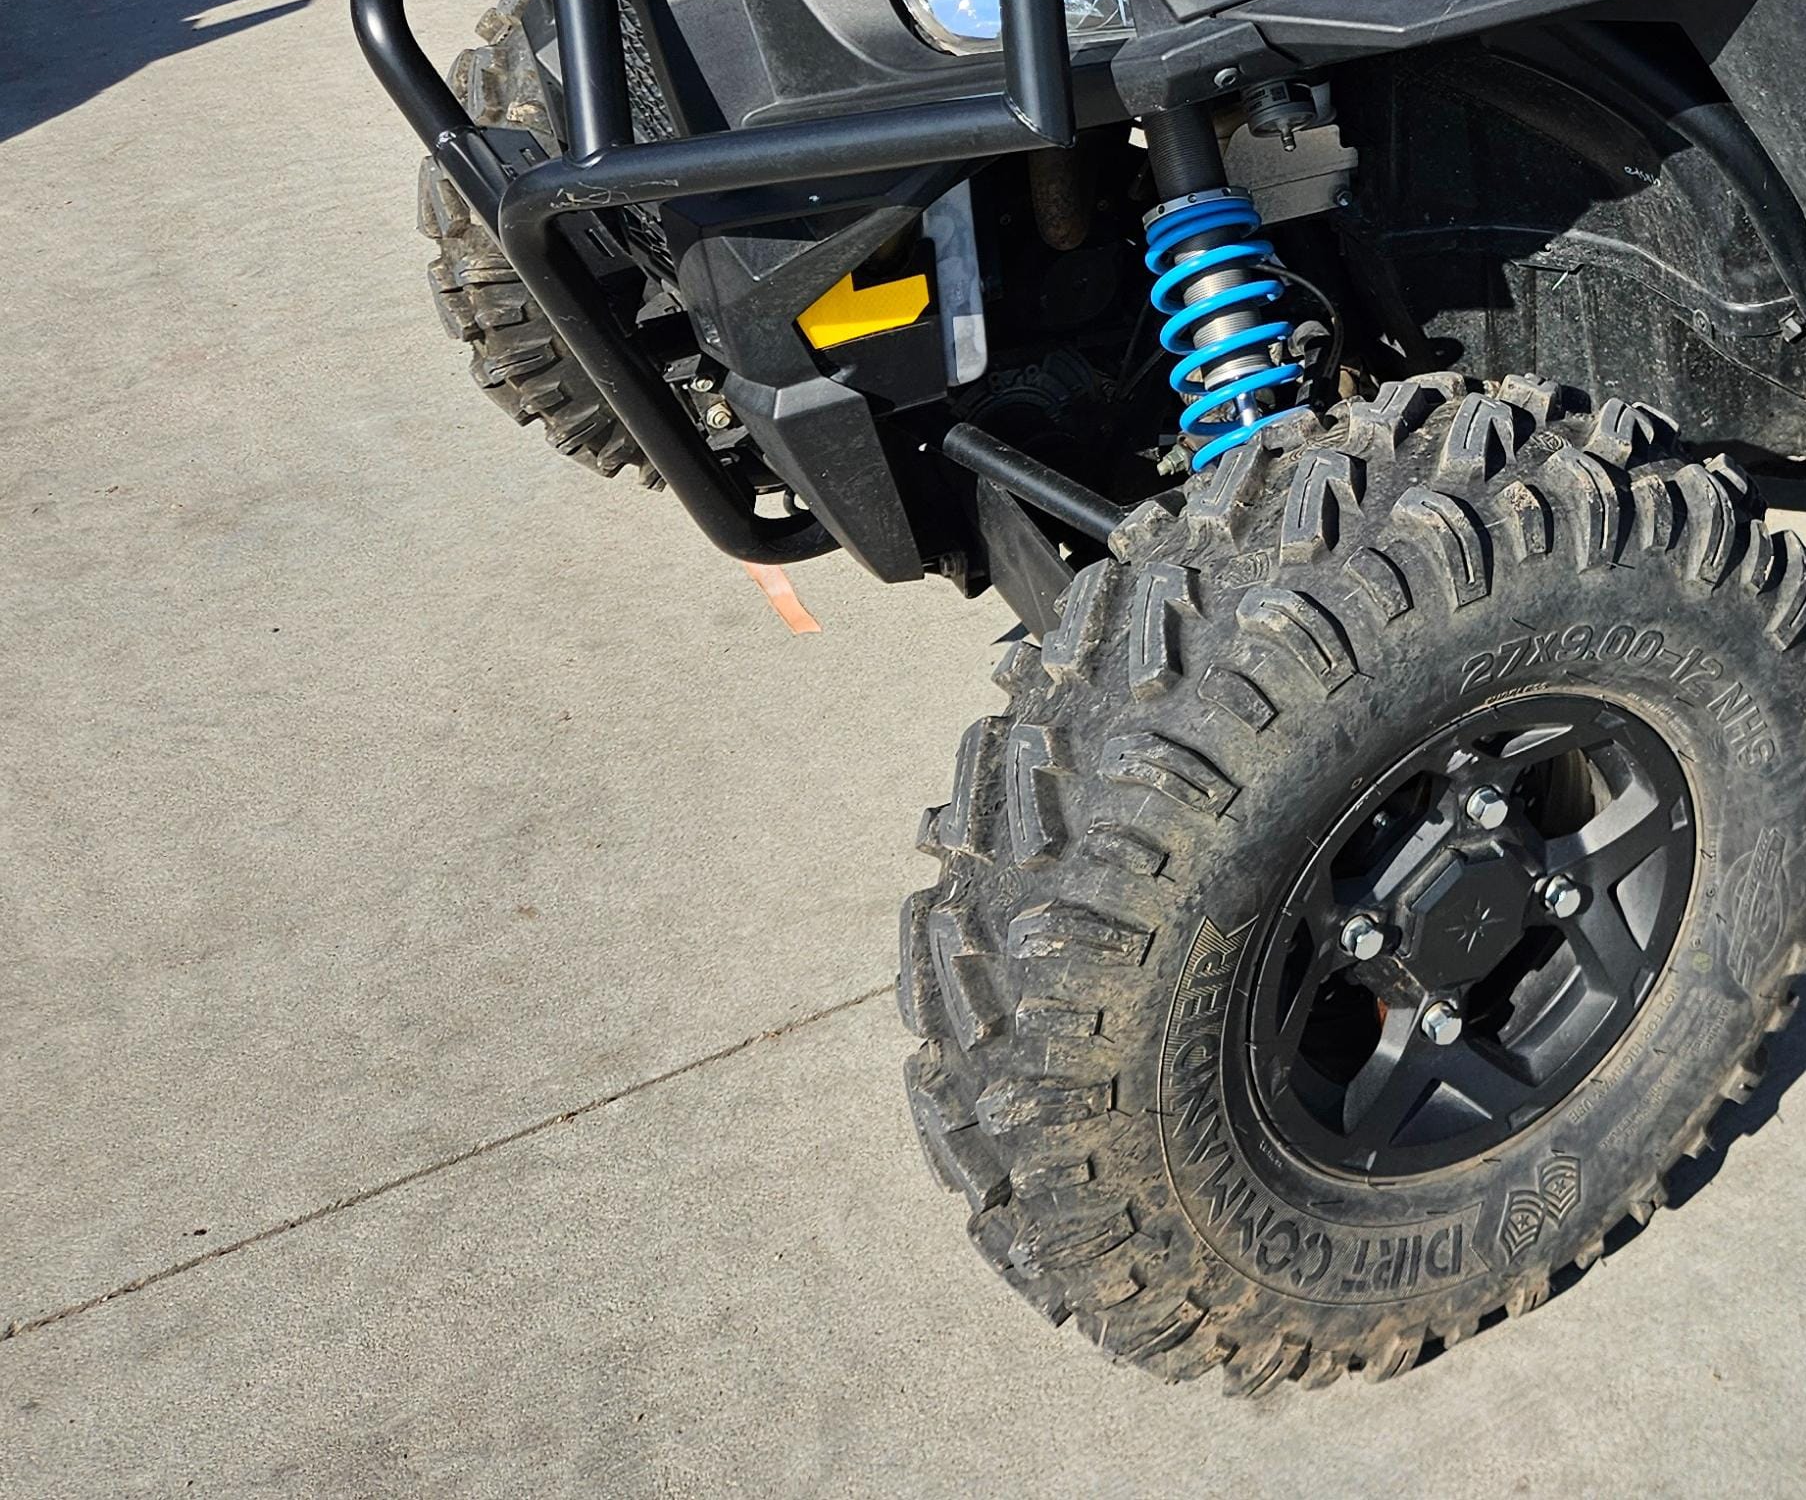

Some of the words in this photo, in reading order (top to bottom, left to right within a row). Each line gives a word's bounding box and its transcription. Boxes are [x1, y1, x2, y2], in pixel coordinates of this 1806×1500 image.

[1706, 681, 1779, 768] NHS
[1168, 950, 1333, 1288] COMMANDER
[1340, 1223, 1463, 1294] DIRT
